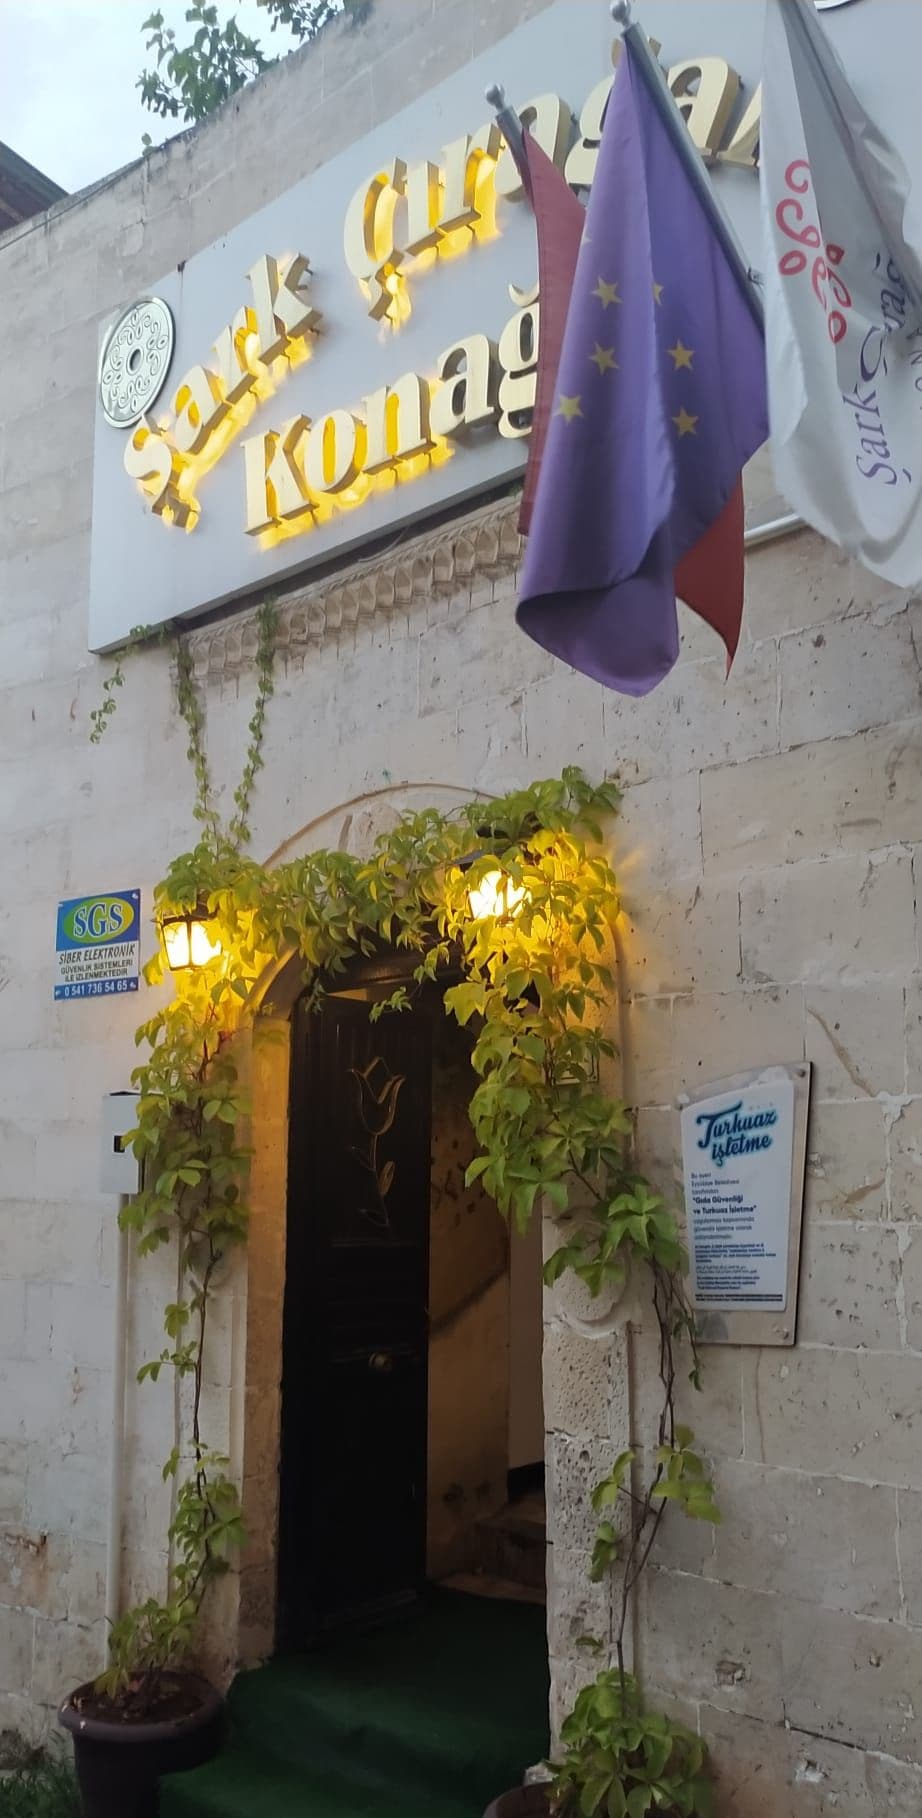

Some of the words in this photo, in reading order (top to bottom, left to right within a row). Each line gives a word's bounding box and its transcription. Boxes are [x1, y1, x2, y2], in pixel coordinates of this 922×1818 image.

[123, 252, 322, 529] Şark
[344, 33, 762, 321] Çırağa
[241, 283, 539, 536] Konağ
[843, 382, 912, 486] Şark
[73, 902, 124, 938] SGS
[64, 986, 70, 996] 0
[71, 984, 85, 996] 541
[87, 982, 102, 994] 736
[104, 980, 115, 992] 54
[117, 979, 128, 990] 65
[696, 1100, 777, 1149] Turkuaz
[711, 1133, 772, 1168] işletme
